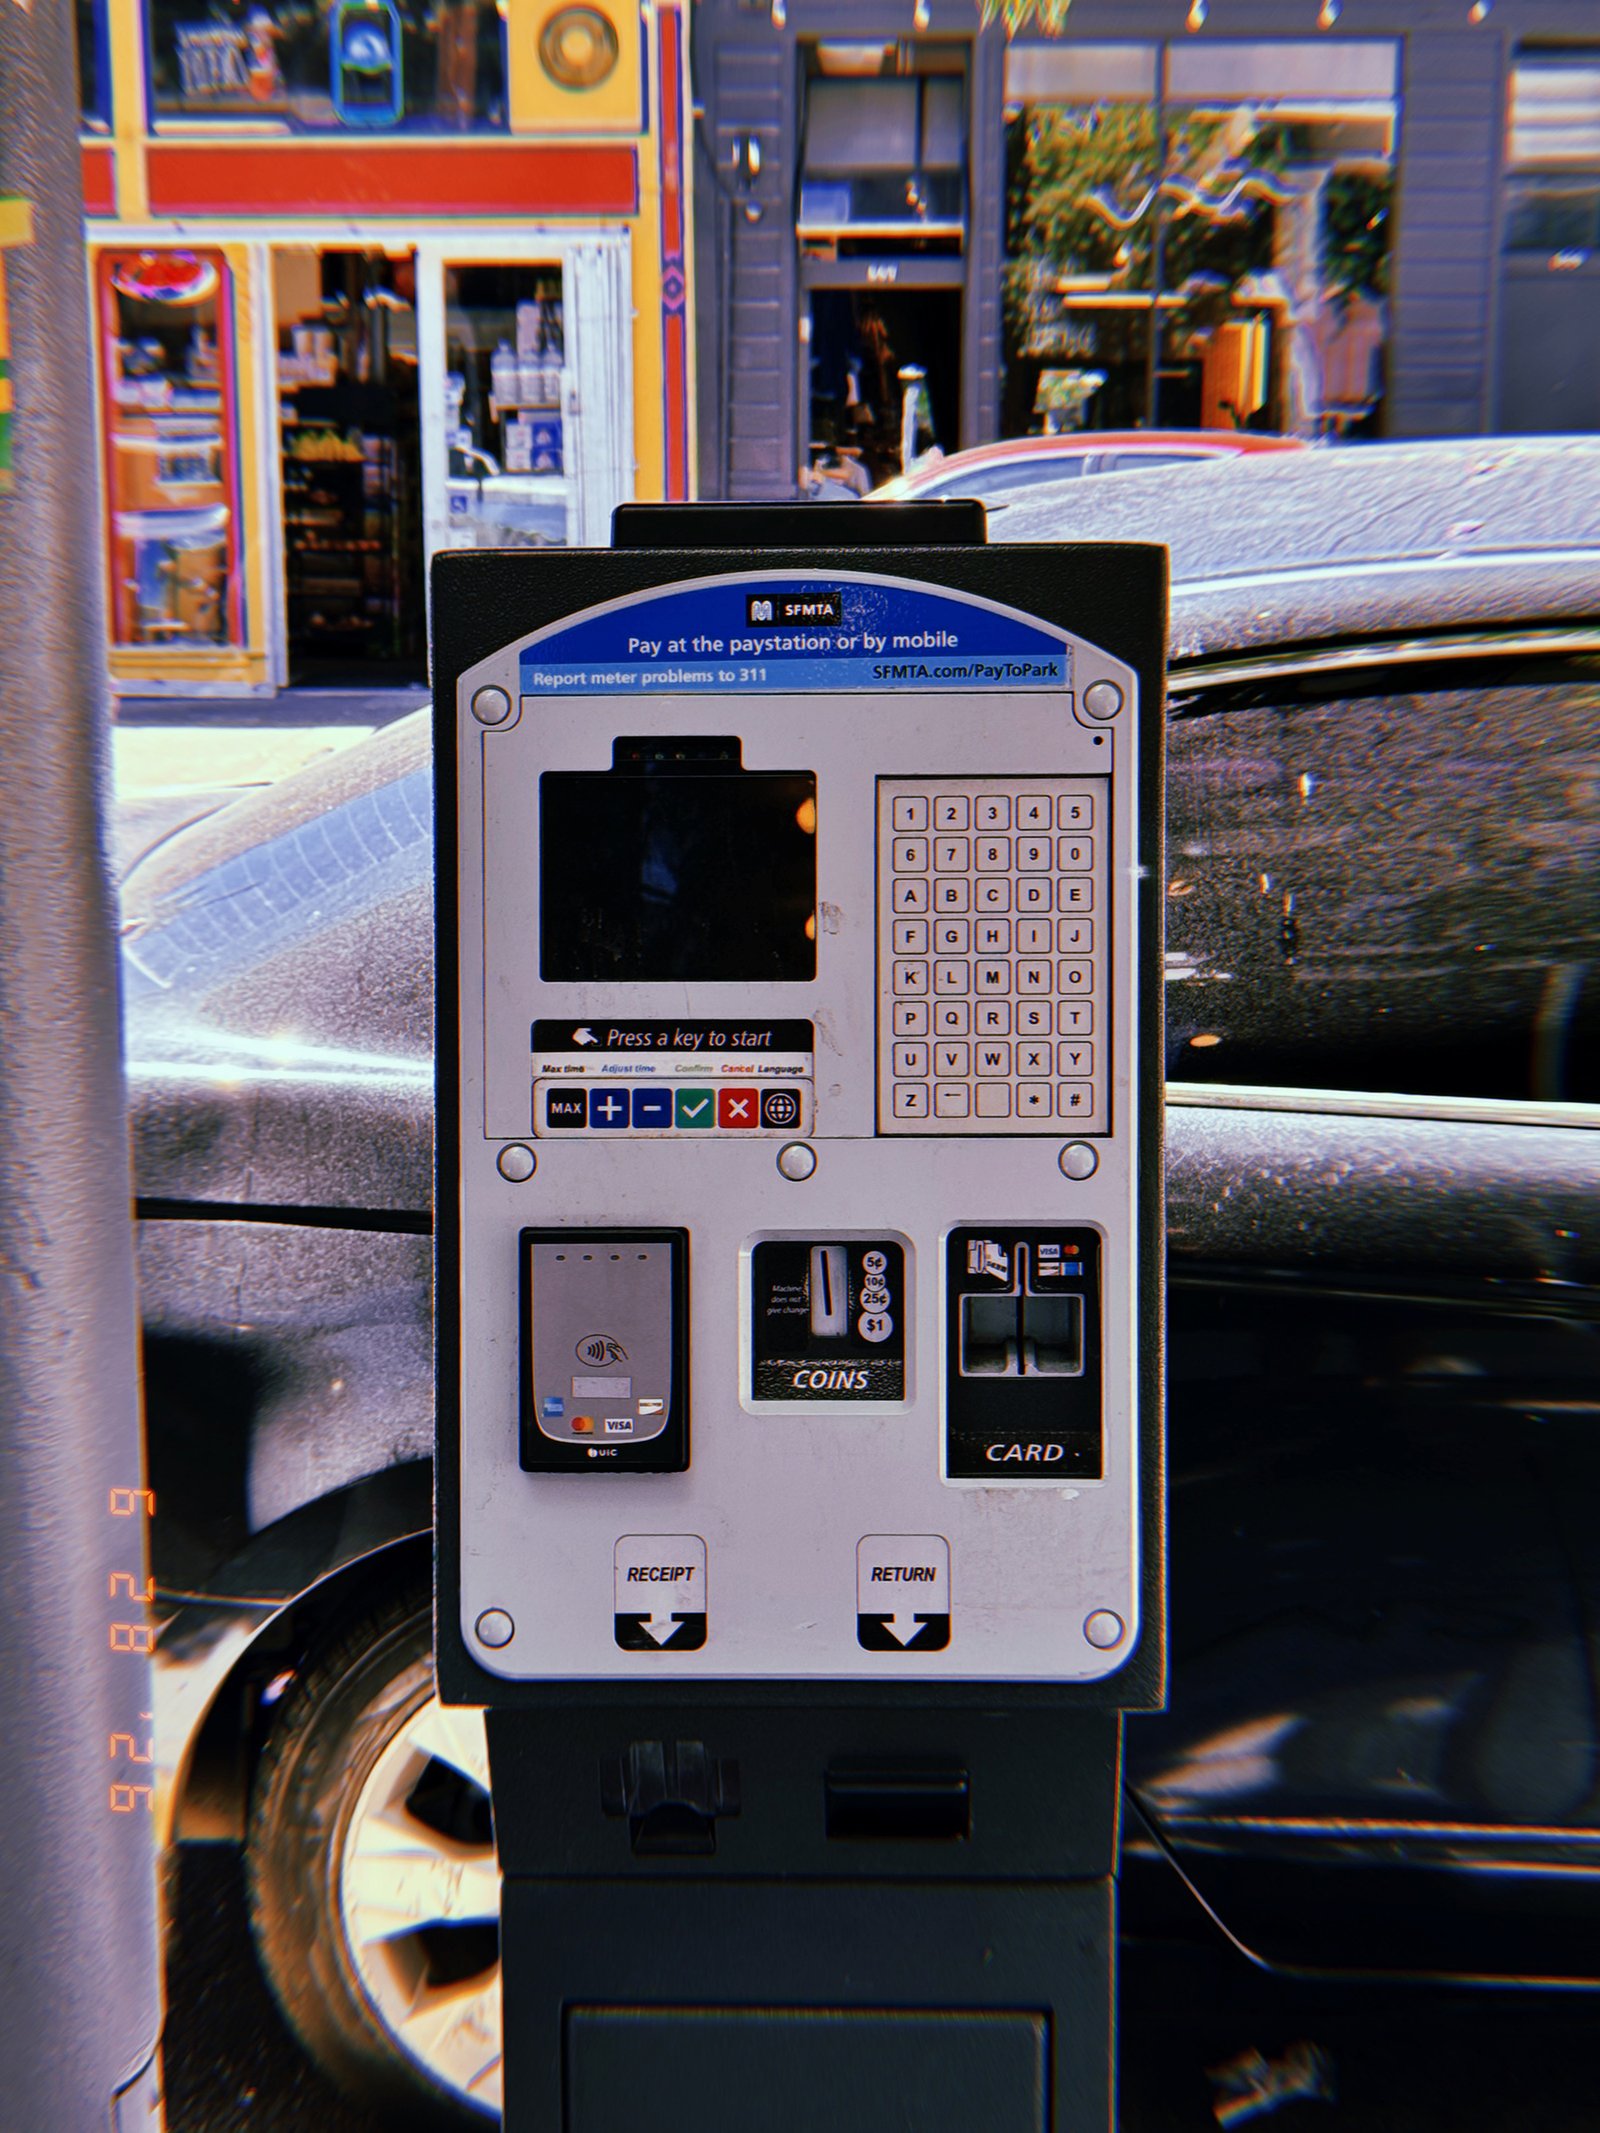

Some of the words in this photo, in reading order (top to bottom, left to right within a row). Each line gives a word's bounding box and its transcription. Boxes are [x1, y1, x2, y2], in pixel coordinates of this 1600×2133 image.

[785, 604, 834, 616] SFMTA
[628, 637, 662, 658] Pay
[667, 638, 687, 653] at
[692, 635, 724, 652] the
[729, 634, 831, 656] paystation
[836, 635, 857, 650] or
[863, 632, 887, 653] by
[893, 631, 959, 648] mobile
[533, 672, 587, 688] Report
[591, 671, 637, 685] meter
[642, 668, 714, 687] problems
[718, 669, 736, 682] to
[739, 668, 767, 682] 311
[872, 662, 1059, 681] SFMTA.com/PayToPark
[906, 807, 914, 821] 1
[946, 807, 957, 820] 2
[988, 806, 998, 820] 3
[1029, 806, 1039, 820] 4
[1070, 806, 1081, 819] 5
[905, 848, 916, 862] 6
[947, 848, 957, 861] 7
[988, 847, 998, 861] 8
[1029, 847, 1039, 861] 9
[1070, 847, 1080, 861] 0
[904, 889, 917, 903] A
[945, 888, 958, 903] B
[986, 888, 999, 902] C
[1028, 888, 1040, 902] D
[1070, 888, 1081, 902] E
[905, 930, 916, 944] F
[945, 930, 958, 944] G
[986, 930, 999, 943] H
[1070, 929, 1080, 943] J
[905, 971, 917, 985] K
[946, 971, 958, 984] L
[986, 970, 1000, 984] M
[1028, 970, 1040, 984] N
[1068, 970, 1082, 984] O
[905, 1012, 917, 1025] P
[945, 1011, 959, 1026] Q
[987, 1011, 999, 1025] R
[1028, 1011, 1040, 1025] S
[1069, 1011, 1081, 1025] T
[606, 1028, 652, 1047] Press
[657, 1032, 668, 1047] a
[673, 1027, 704, 1051] key
[708, 1030, 726, 1047] to
[731, 1030, 773, 1047] start
[905, 1053, 917, 1067] U
[945, 1053, 958, 1066] V
[984, 1052, 1001, 1066] W
[1028, 1052, 1040, 1066] X
[1069, 1052, 1081, 1066] Y
[542, 1064, 562, 1073] Max
[564, 1064, 586, 1073] time
[601, 1064, 634, 1074] Adjust
[635, 1064, 656, 1073] time
[674, 1064, 714, 1073] Confirm
[720, 1064, 755, 1073] Cancel
[757, 1064, 804, 1075] Language
[551, 1102, 582, 1114] MAX
[905, 1094, 917, 1107] Z
[1039, 1247, 1059, 1256] VISA
[866, 1257, 883, 1270] 5¢
[865, 1276, 885, 1287] 10¢
[863, 1292, 887, 1306] 25¢
[866, 1318, 884, 1333] $1
[792, 1369, 869, 1390] COINS
[606, 1421, 632, 1431] VISA
[986, 1443, 1064, 1462] CARD
[626, 1566, 696, 1582] RECEIPT
[871, 1566, 937, 1582] RETURN
